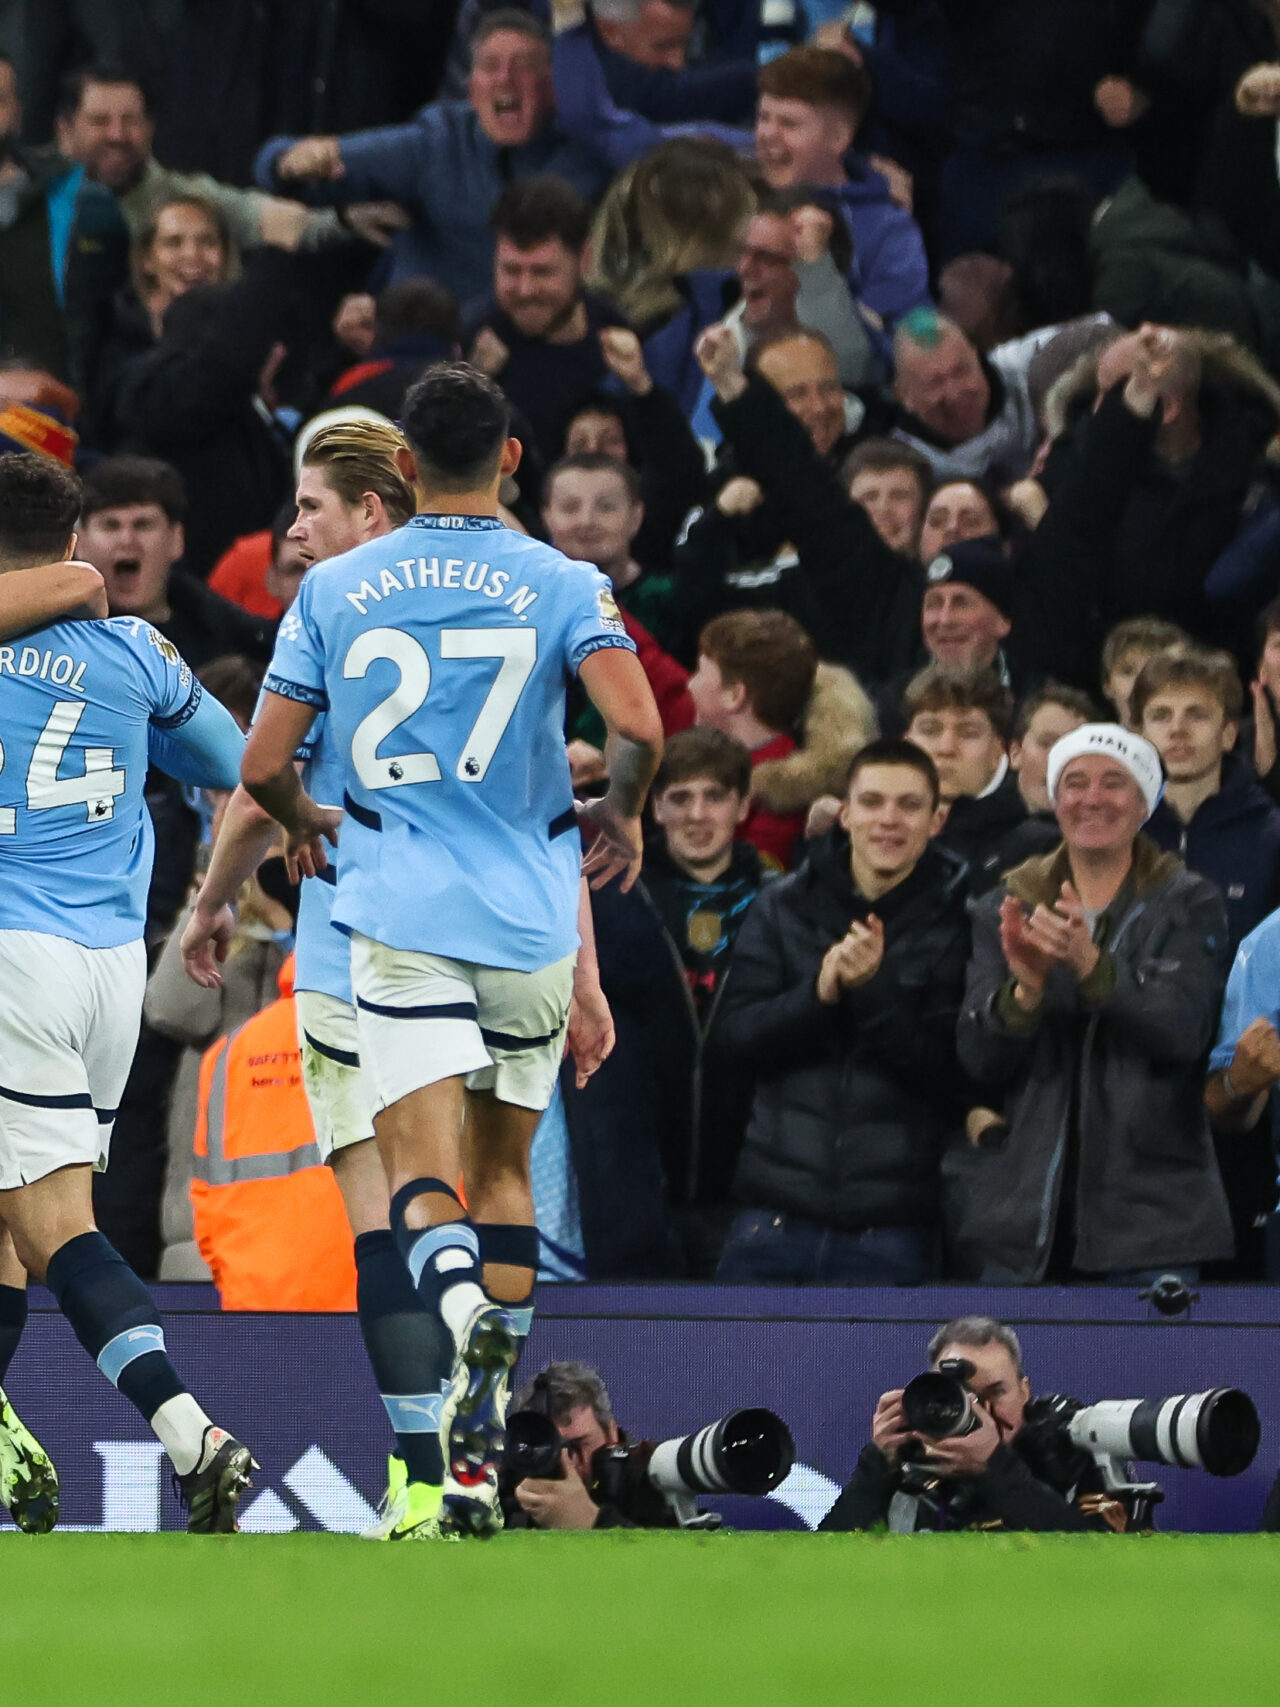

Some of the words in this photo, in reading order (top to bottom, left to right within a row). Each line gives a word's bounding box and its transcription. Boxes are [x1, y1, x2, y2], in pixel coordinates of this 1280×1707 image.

[345, 557, 510, 615] MATHEUS
[504, 585, 538, 622] N.
[343, 627, 538, 790] 27
